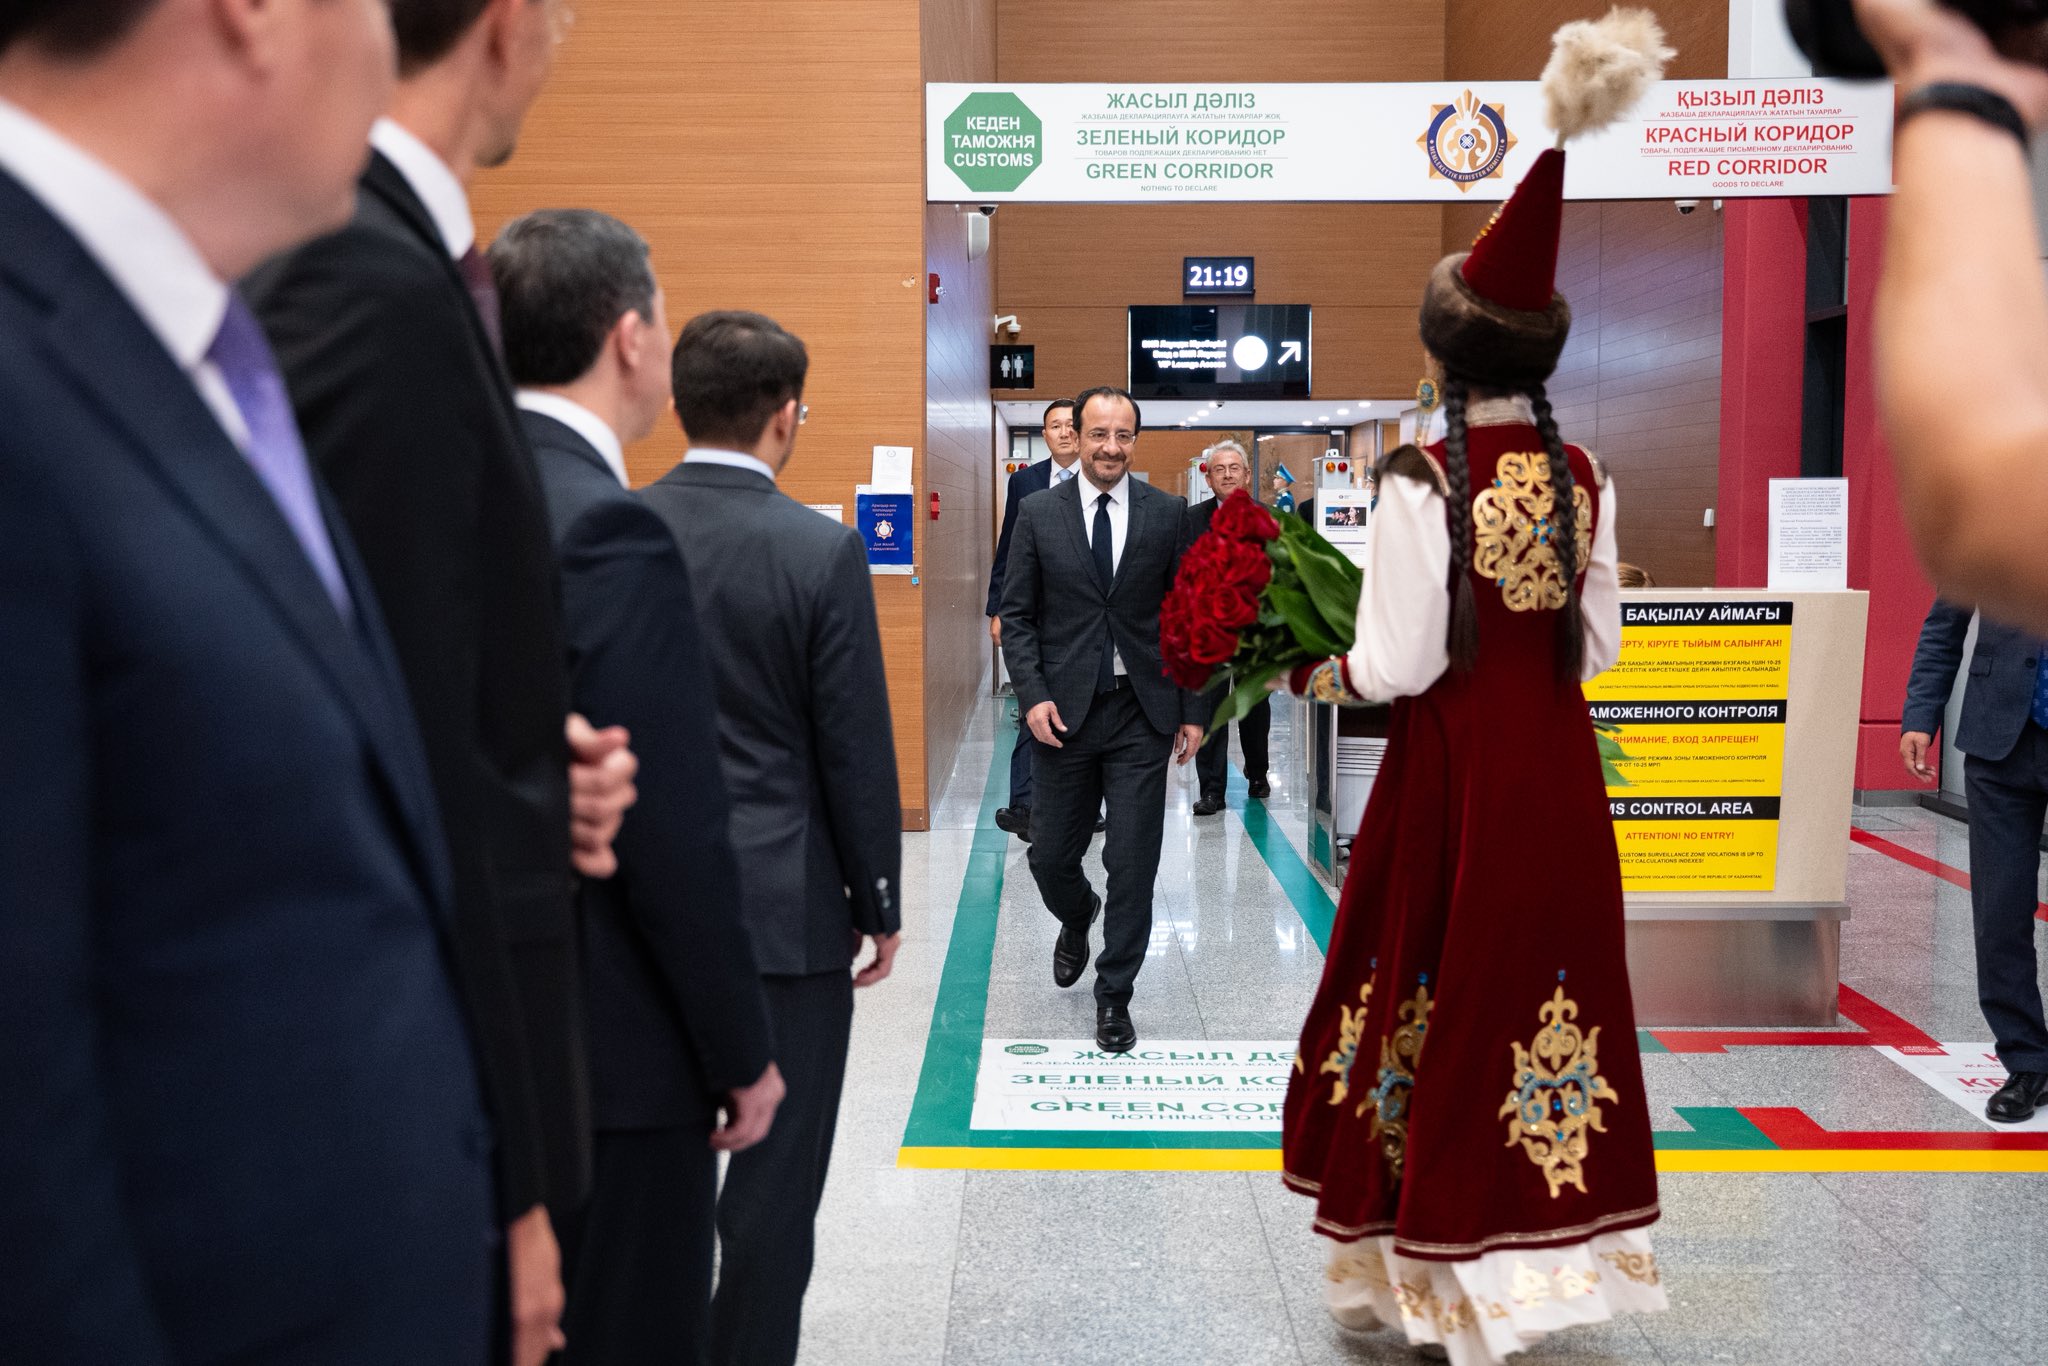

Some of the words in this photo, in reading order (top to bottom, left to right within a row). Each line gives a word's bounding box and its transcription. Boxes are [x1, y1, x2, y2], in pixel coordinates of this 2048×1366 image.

[1106, 92, 1187, 109] ЖАСЫЛ
[1193, 92, 1256, 112] ДӘЛІЗ
[1677, 90, 1756, 110] ҚЫЗЫЛ
[1761, 88, 1824, 108] ДӘЛІЗ
[966, 116, 1021, 133] КЕДЕН
[1076, 125, 1179, 145] ЗЕЛЕНЫЙ
[1186, 129, 1286, 148] КОРИДОР
[1645, 122, 1747, 143] КРАСНЫЙ
[1754, 124, 1855, 144] КОРИДОР
[951, 134, 1036, 149] ТАМОЖНЯ
[1783, 144, 1853, 152] ДЕКЛАРИРОВАНИЮ
[953, 152, 1034, 167] CUSTOMS
[1129, 149, 1181, 157] ПОДЛЕЖАЩИХ
[1182, 149, 1252, 157] ДЕКЛАРИРОВАНИЮ
[1086, 163, 1157, 179] GREEN
[1163, 163, 1274, 179] CORRIDOR
[1668, 160, 1711, 176] RED
[1716, 158, 1828, 176] CORRIDOR
[1189, 265, 1249, 287] 21:19
[1626, 608, 1705, 624] БАҚЫЛАУ
[1708, 604, 1781, 621] АЙМАҒЫ
[1618, 640, 1645, 649] ЕРТУ,
[1647, 640, 1680, 648] КІРУГЕ
[1682, 638, 1721, 648] ТЫЙЫМ
[1723, 639, 1783, 648] САЛЫНҒАН!
[1588, 706, 1694, 719] АМОЖЕННОГО
[1698, 705, 1778, 718] КОНТРОЛЯ
[1612, 735, 1670, 745] ВНИМАНИЕ,
[1672, 735, 1699, 745] ВХОД
[1701, 735, 1759, 744] ЗАПРЕЩЕН!
[1629, 802, 1706, 815] CONTROL
[1709, 802, 1754, 815] AREA
[1625, 832, 1681, 840] ATTENTION!
[1683, 832, 1698, 840] NO
[1700, 831, 1735, 840] ENTRY!
[1072, 1050, 1234, 1060] ЖАСЫЛ
[1248, 1051, 1297, 1063] ДӘ
[1010, 1073, 1224, 1085] ЗЕЛЕНЫЙ
[1240, 1076, 1290, 1085] КО
[1956, 1077, 2007, 1088] КР
[1030, 1101, 1184, 1112] GREEN
